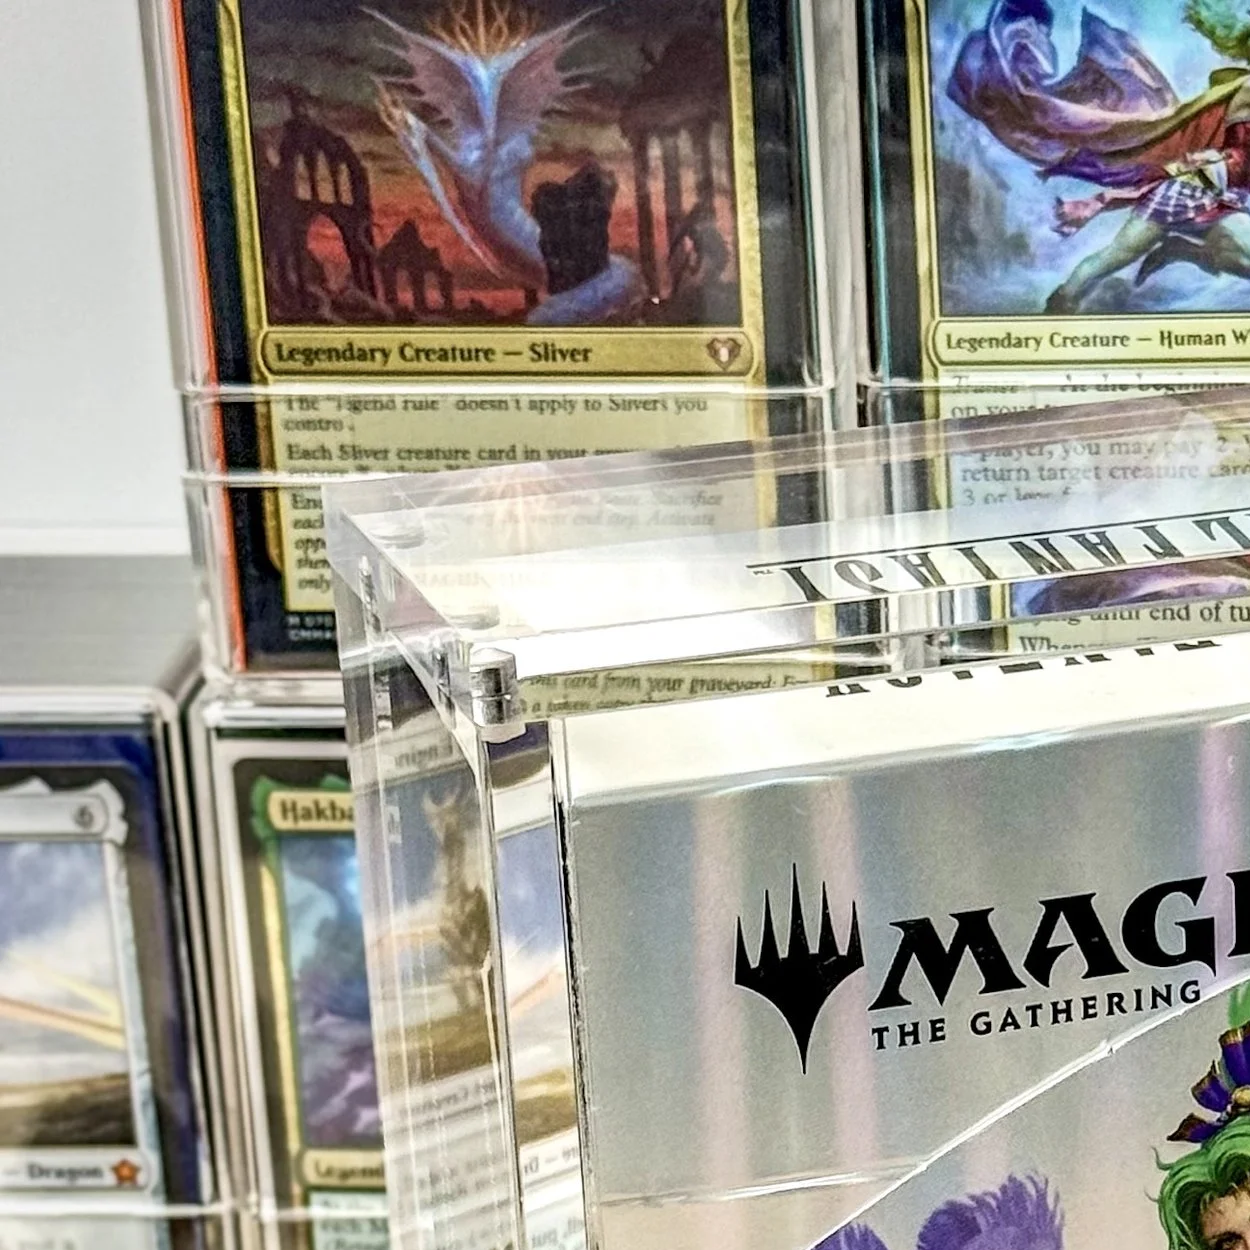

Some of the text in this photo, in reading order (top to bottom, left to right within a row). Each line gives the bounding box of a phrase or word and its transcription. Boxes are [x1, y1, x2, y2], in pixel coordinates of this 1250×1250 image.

[945, 331, 1044, 353] Legendary
[1044, 331, 1130, 348] Creature
[1159, 329, 1227, 349] Human
[276, 342, 392, 366] Legendary
[400, 342, 496, 363] Creature
[530, 342, 593, 363] Sliver
[584, 397, 602, 411] to
[674, 399, 708, 415] you
[286, 442, 333, 461] Each
[337, 441, 389, 461] Sliver
[396, 444, 471, 461] creature
[477, 443, 517, 461] card
[523, 444, 541, 461] in
[1060, 443, 1101, 462] you
[1109, 443, 1156, 460] may
[961, 466, 1030, 482] return
[1038, 464, 1102, 484] target
[1108, 460, 1200, 480] creature
[1148, 603, 1191, 622] end
[1198, 601, 1225, 622] of
[871, 979, 1202, 1052] THE GATHERING
[28, 1163, 103, 1181] Dragon
